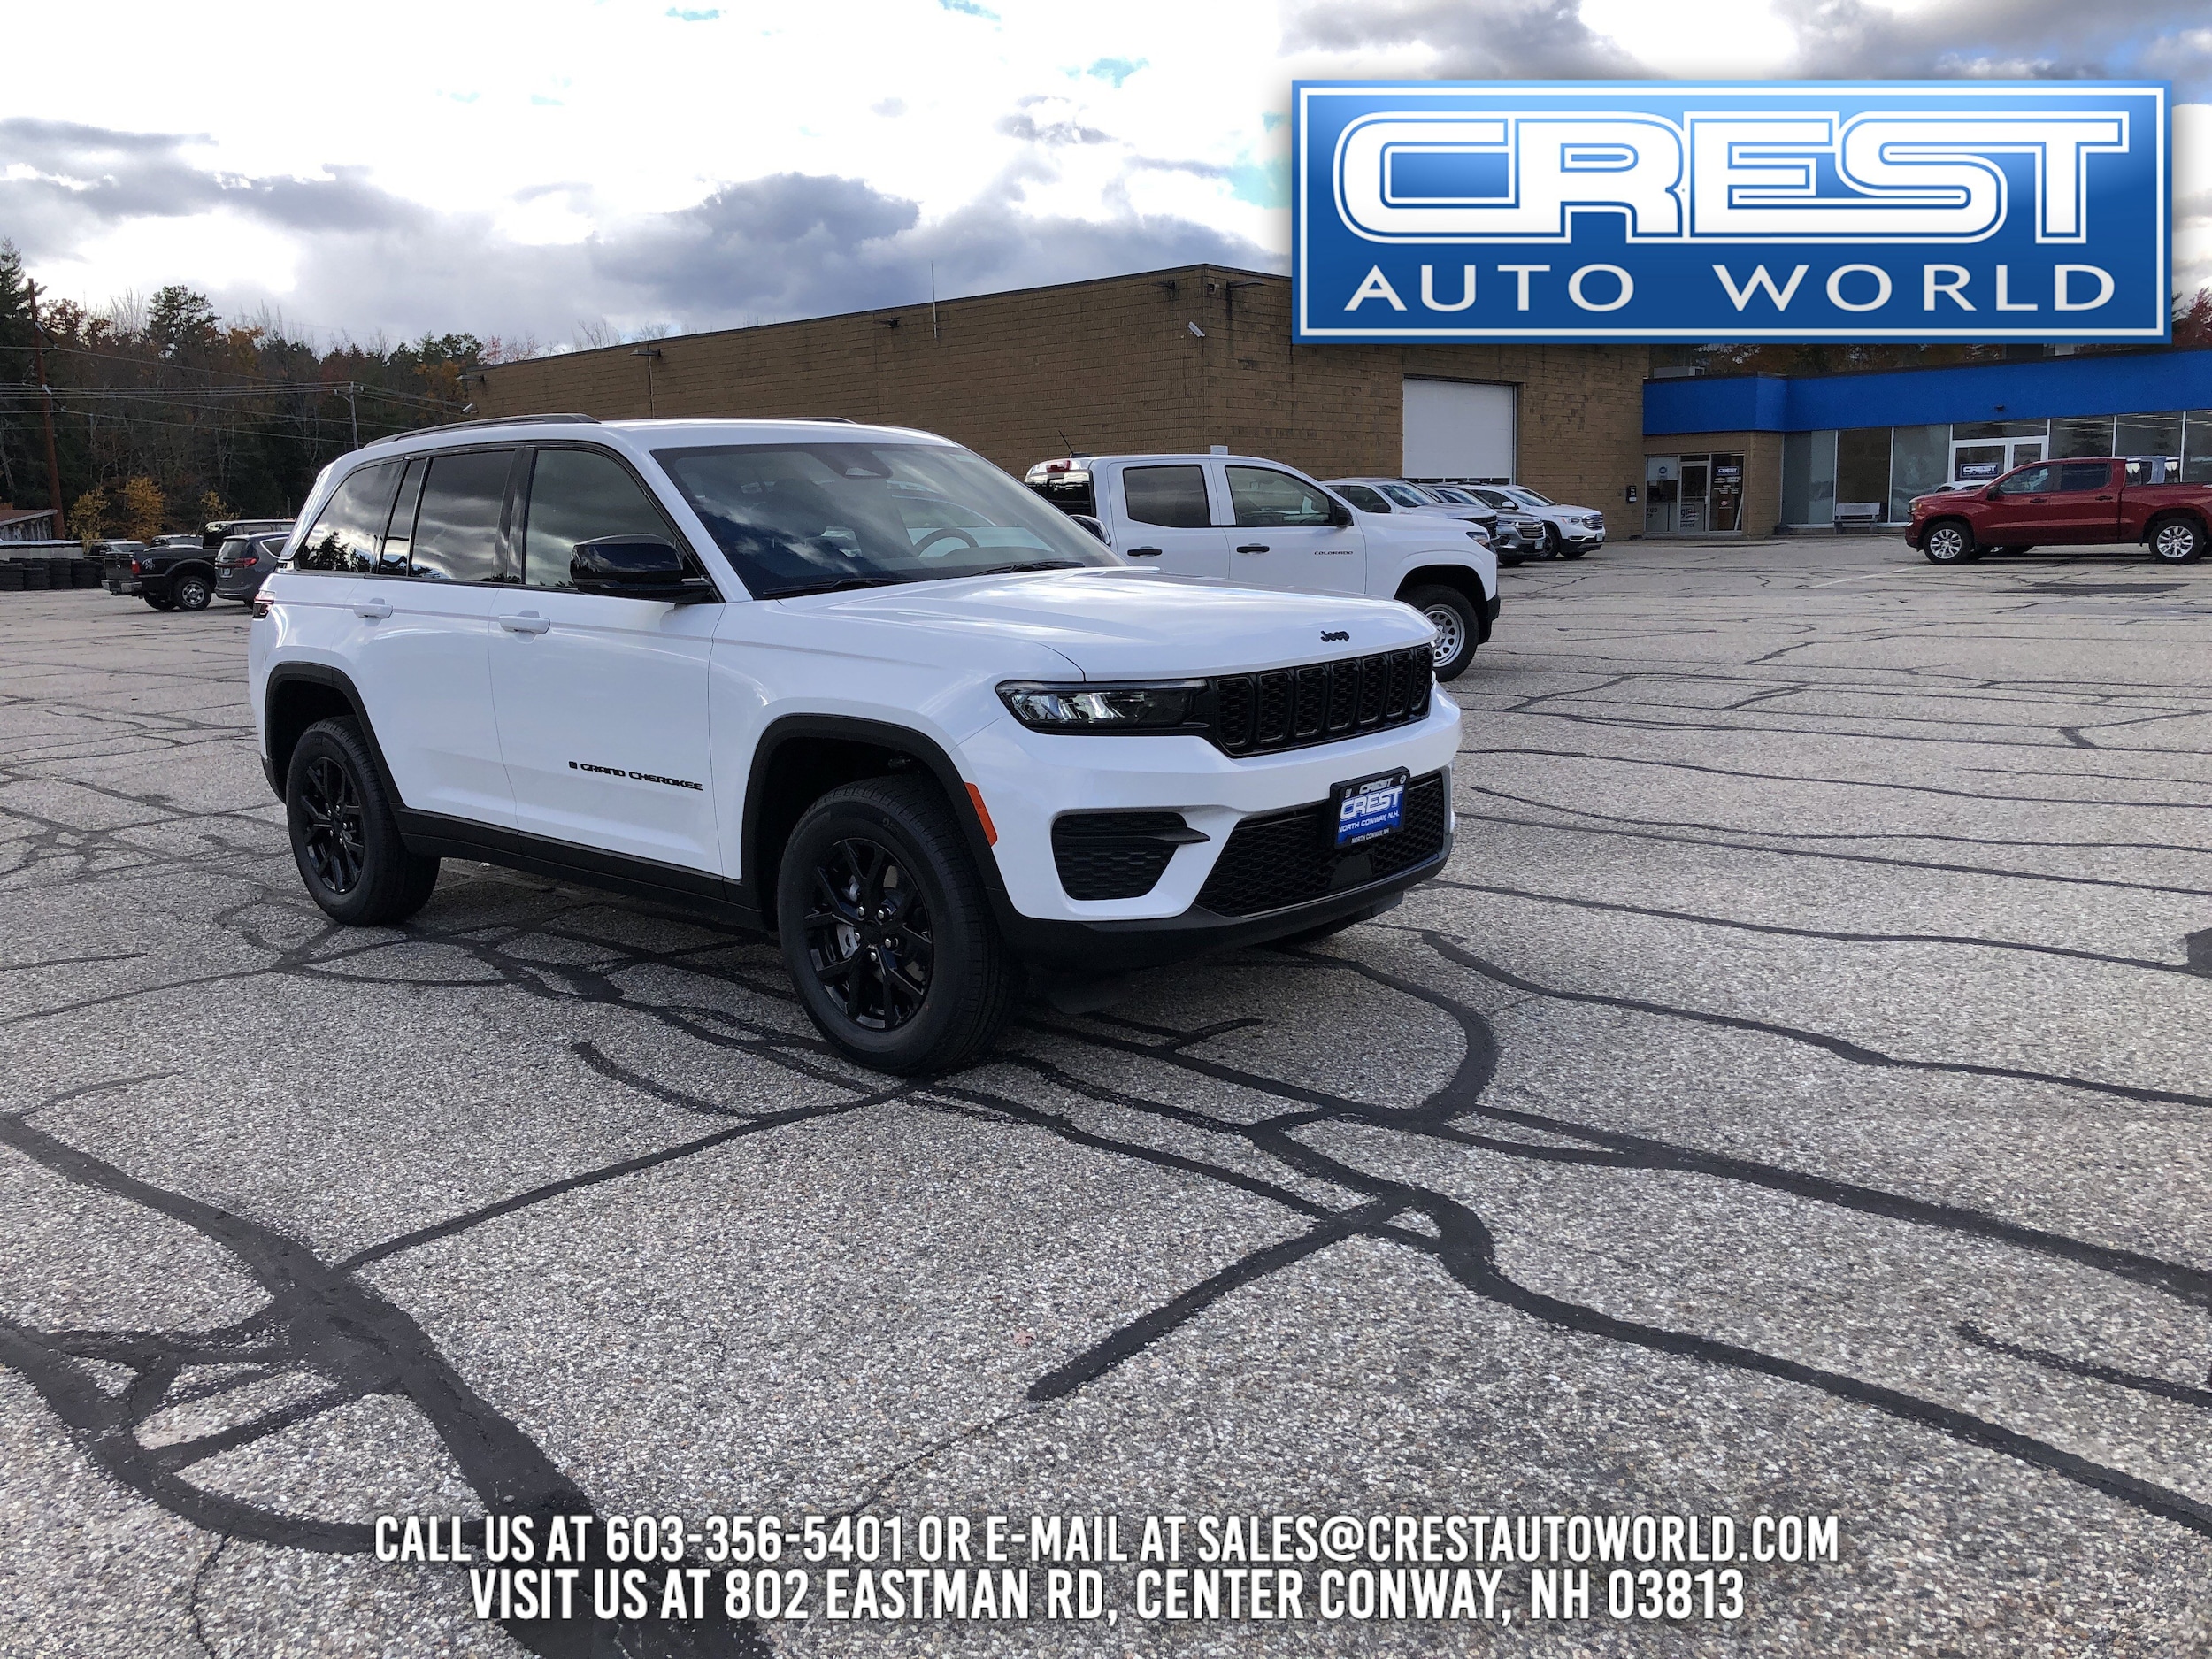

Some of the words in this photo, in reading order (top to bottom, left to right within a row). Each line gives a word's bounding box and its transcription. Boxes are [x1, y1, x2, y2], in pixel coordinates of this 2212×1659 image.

[1320, 630, 1350, 642] Jeep
[580, 763, 626, 777] GRAND
[628, 771, 703, 792] CHEROKEE
[1358, 777, 1394, 795] CREST
[1340, 786, 1404, 821] CREST
[1338, 821, 1360, 833] NORTH
